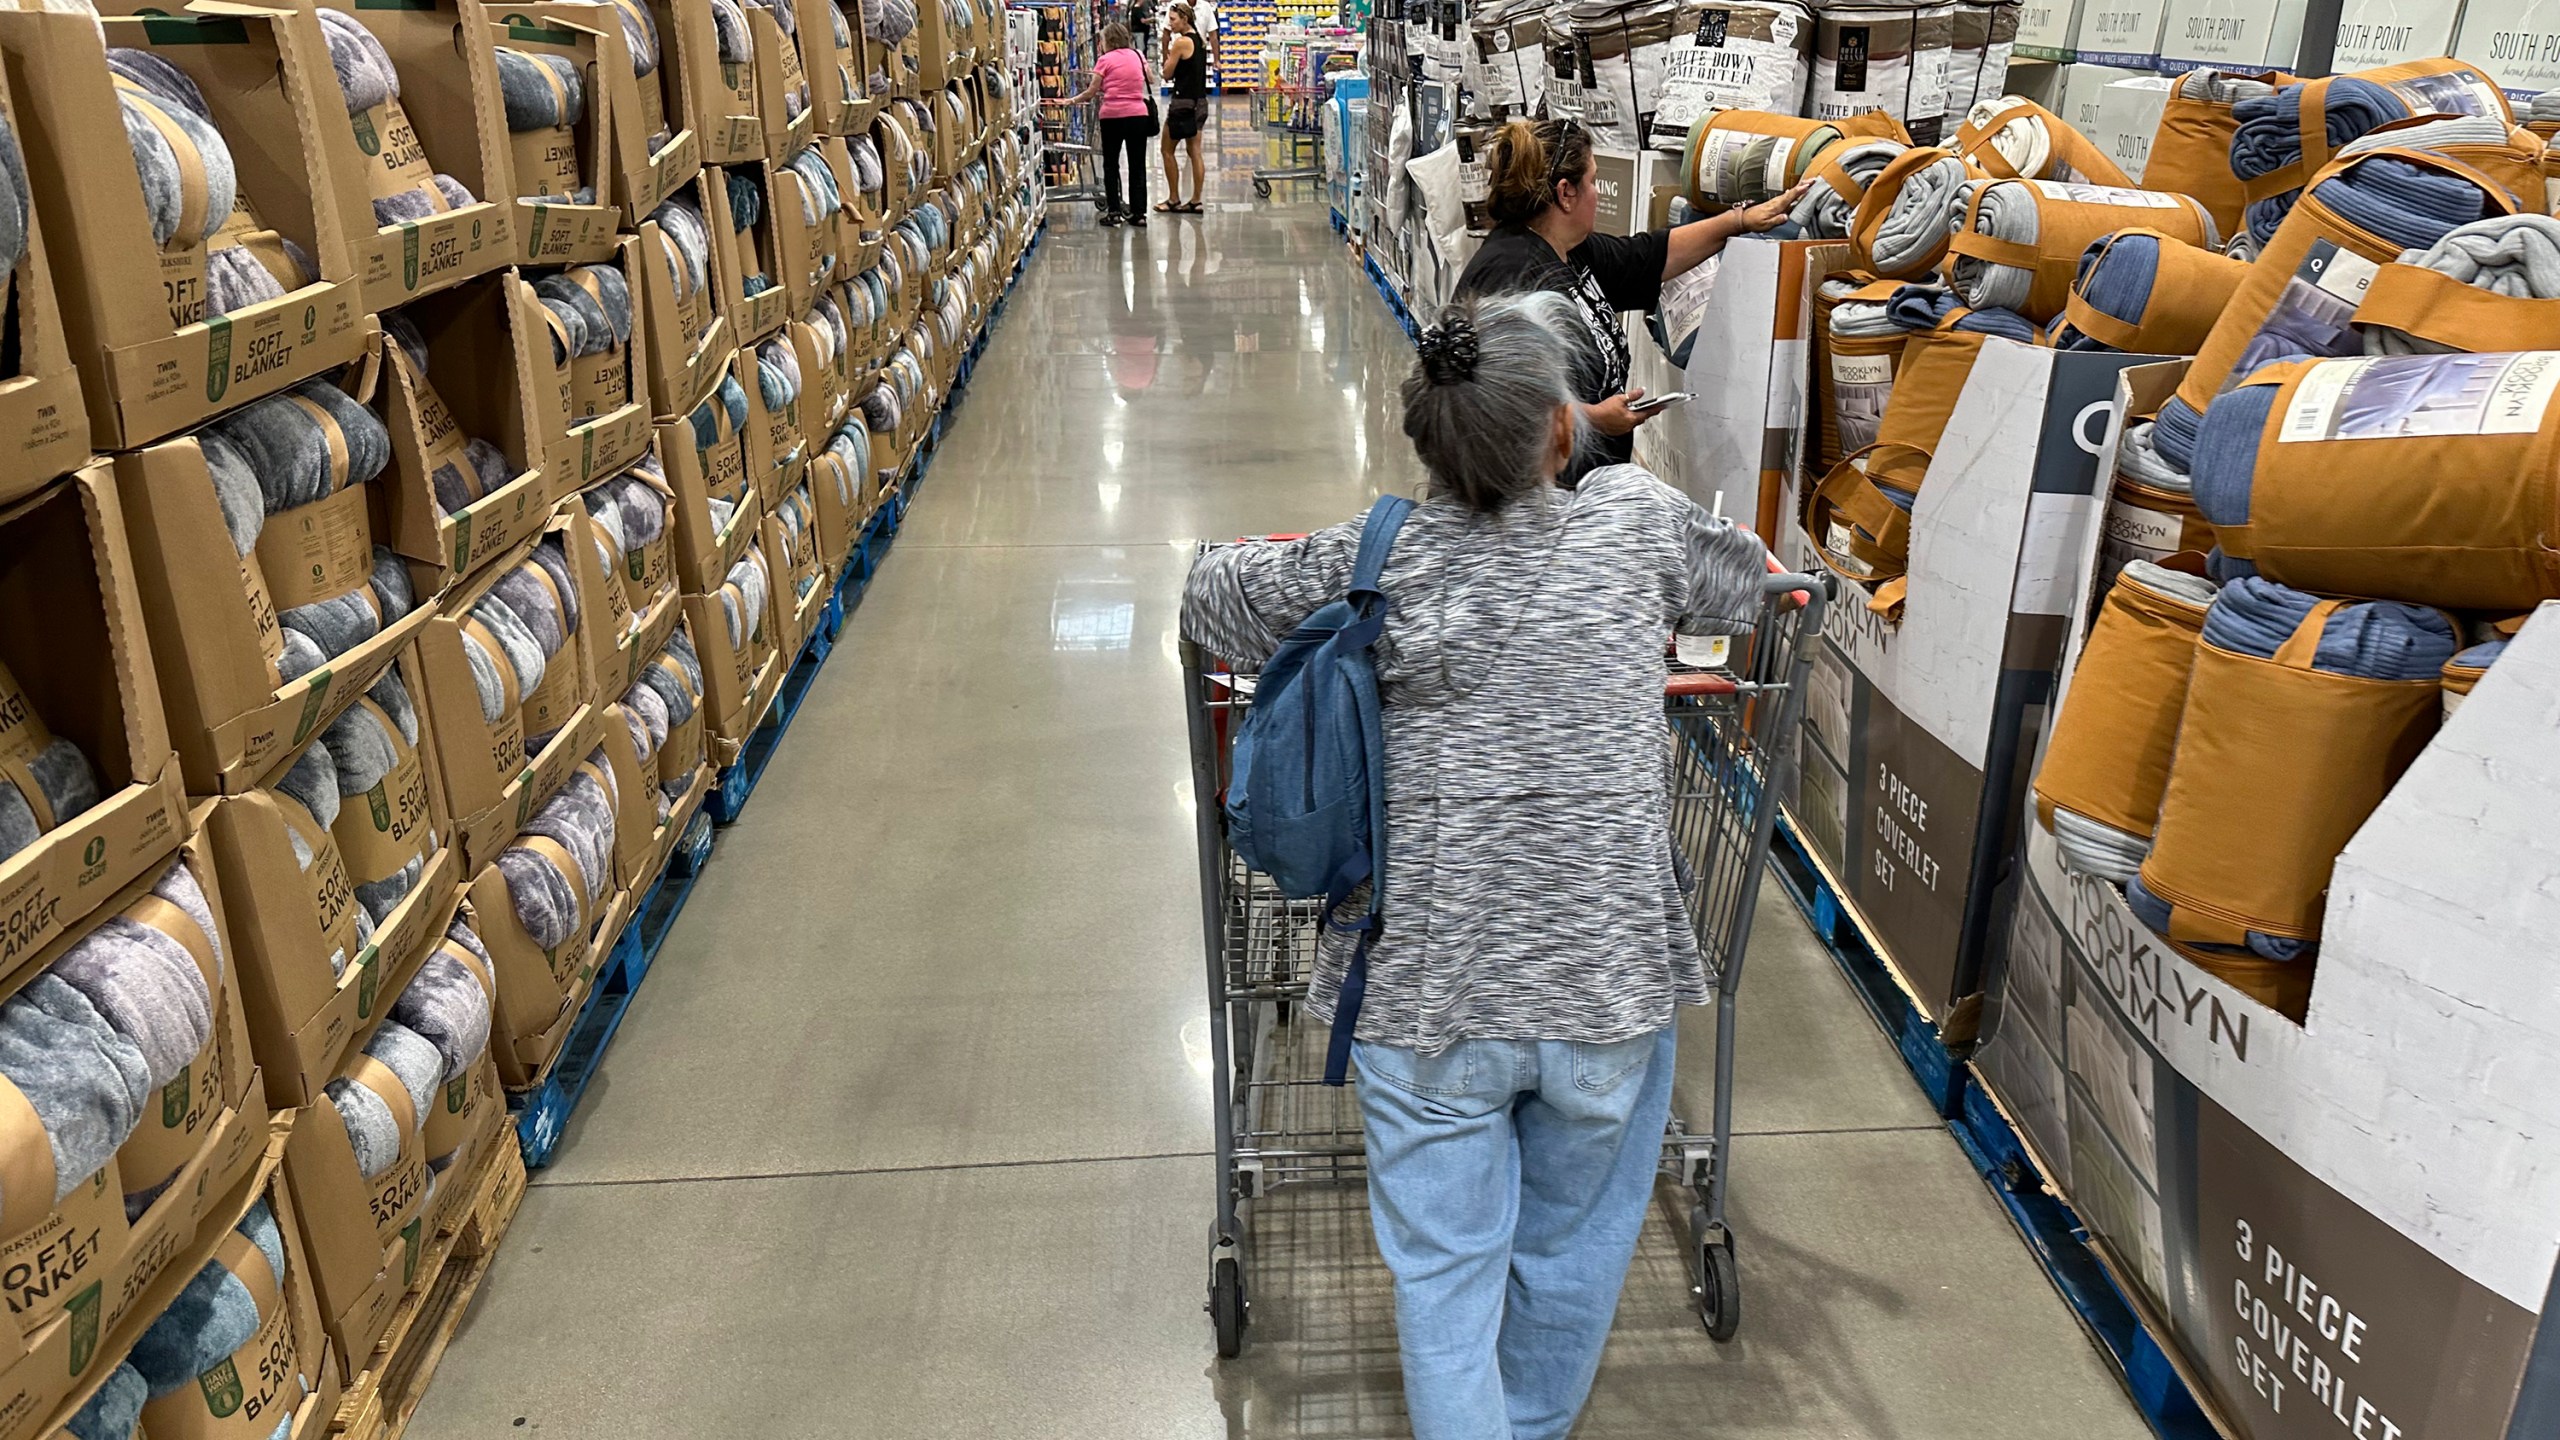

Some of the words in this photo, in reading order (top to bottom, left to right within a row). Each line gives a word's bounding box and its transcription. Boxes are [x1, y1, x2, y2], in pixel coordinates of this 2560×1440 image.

[1778, 19, 1795, 29] KING
[2096, 12, 2119, 32] SOUTH
[2119, 13, 2142, 33] POINT
[2185, 17, 2216, 40] SOUTH
[2216, 18, 2246, 41] POINT
[2335, 23, 2371, 48] OUTH
[2374, 25, 2413, 52] POINT
[2490, 31, 2539, 61] SOUTH
[1712, 51, 1757, 72] DOWN
[2105, 54, 2117, 64] PIECE
[2117, 55, 2132, 64] SHEET
[2132, 56, 2142, 65] SET
[2169, 61, 2190, 72] QUEEN
[2502, 64, 2524, 76] home
[2079, 103, 2100, 124] SOUT
[388, 125, 412, 148] SOFT
[2116, 133, 2149, 160] SOUTH
[383, 144, 425, 170] BLANKE
[1595, 177, 1618, 197] KING
[430, 238, 456, 258] SOFT
[549, 230, 571, 242] SOFT
[541, 243, 573, 256] BLANKET
[421, 251, 463, 276] BLANKET
[2310, 257, 2323, 273] Q
[164, 278, 197, 303] OFT
[170, 300, 206, 328] NKET
[680, 315, 696, 333] OFT
[248, 331, 284, 359] SOFT
[157, 360, 178, 374] TWIN
[234, 346, 292, 384] BLANKET
[594, 360, 626, 385] ANKET
[1838, 365, 1882, 376] BROOKLYN
[1843, 373, 1867, 382] LOOM
[423, 415, 455, 448] LANKE
[599, 440, 615, 457] SOFT
[716, 450, 741, 471] SOFT
[592, 452, 619, 472] BLANKET
[708, 459, 743, 487] BLANKE
[479, 520, 503, 543] SOFT
[2107, 511, 2167, 537] ROOKLYN
[2107, 525, 2143, 543] OOM
[470, 530, 508, 564] BLANKET
[651, 554, 666, 572] SOF
[643, 565, 670, 589] BLANK
[1822, 600, 1858, 661] OOM
[251, 729, 275, 746] TWIN
[496, 738, 524, 774] ANKE
[399, 772, 425, 813] SOFT
[1878, 762, 1887, 792] 3
[1890, 772, 1928, 832] PIECE
[391, 791, 429, 842] BLANKE
[1876, 805, 1941, 892] COVERLET
[1875, 848, 1896, 892] SET
[317, 858, 346, 909] SOFT
[319, 874, 351, 933] LANKE
[368, 1161, 417, 1215] SOFT
[375, 1165, 426, 1229] ANKET
[3, 1213, 65, 1255] RKSHIRE
[2, 1227, 77, 1290] OFT
[6, 1227, 101, 1314] ANKET
[122, 1231, 170, 1299] SOFT
[2235, 1218, 2254, 1263] 3
[2265, 1244, 2368, 1364] PIECE
[258, 1317, 293, 1381] SOFT
[2235, 1278, 2403, 1440] COVERLET
[243, 1333, 297, 1421] BLANKE
[2235, 1335, 2286, 1415] SET
